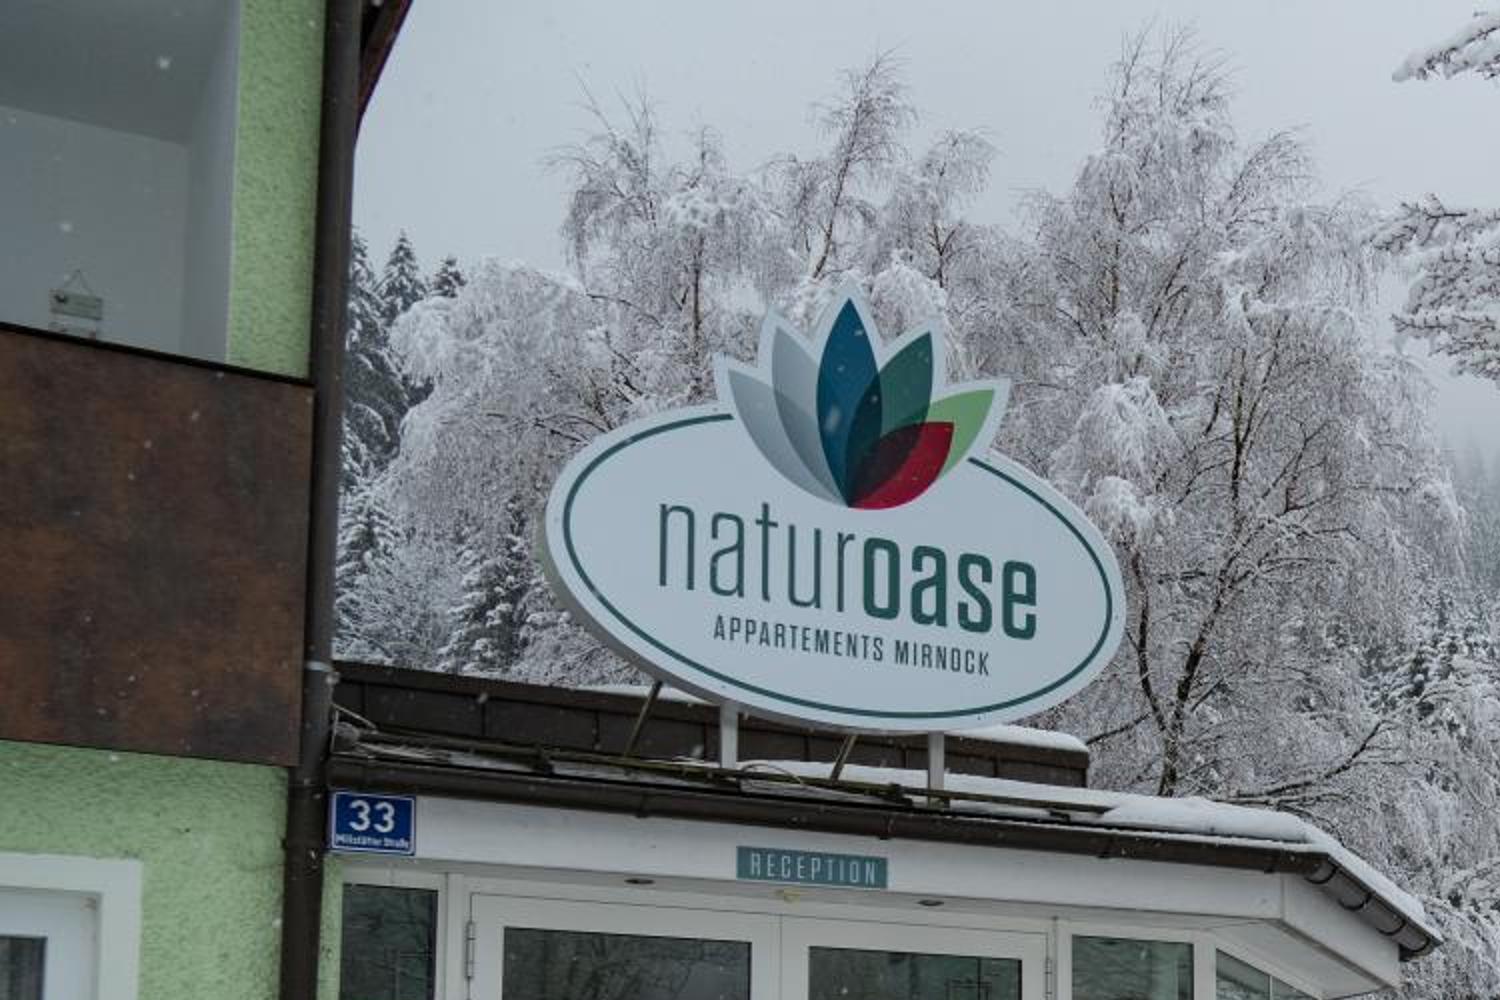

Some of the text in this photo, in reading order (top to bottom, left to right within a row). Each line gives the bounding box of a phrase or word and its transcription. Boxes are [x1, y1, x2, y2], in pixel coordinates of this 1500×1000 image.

[658, 502, 1037, 640] naturoase
[713, 615, 990, 676] APPARTEMENTS MIRNOCK
[349, 799, 395, 833] 33
[751, 852, 875, 885] RECEPTION
